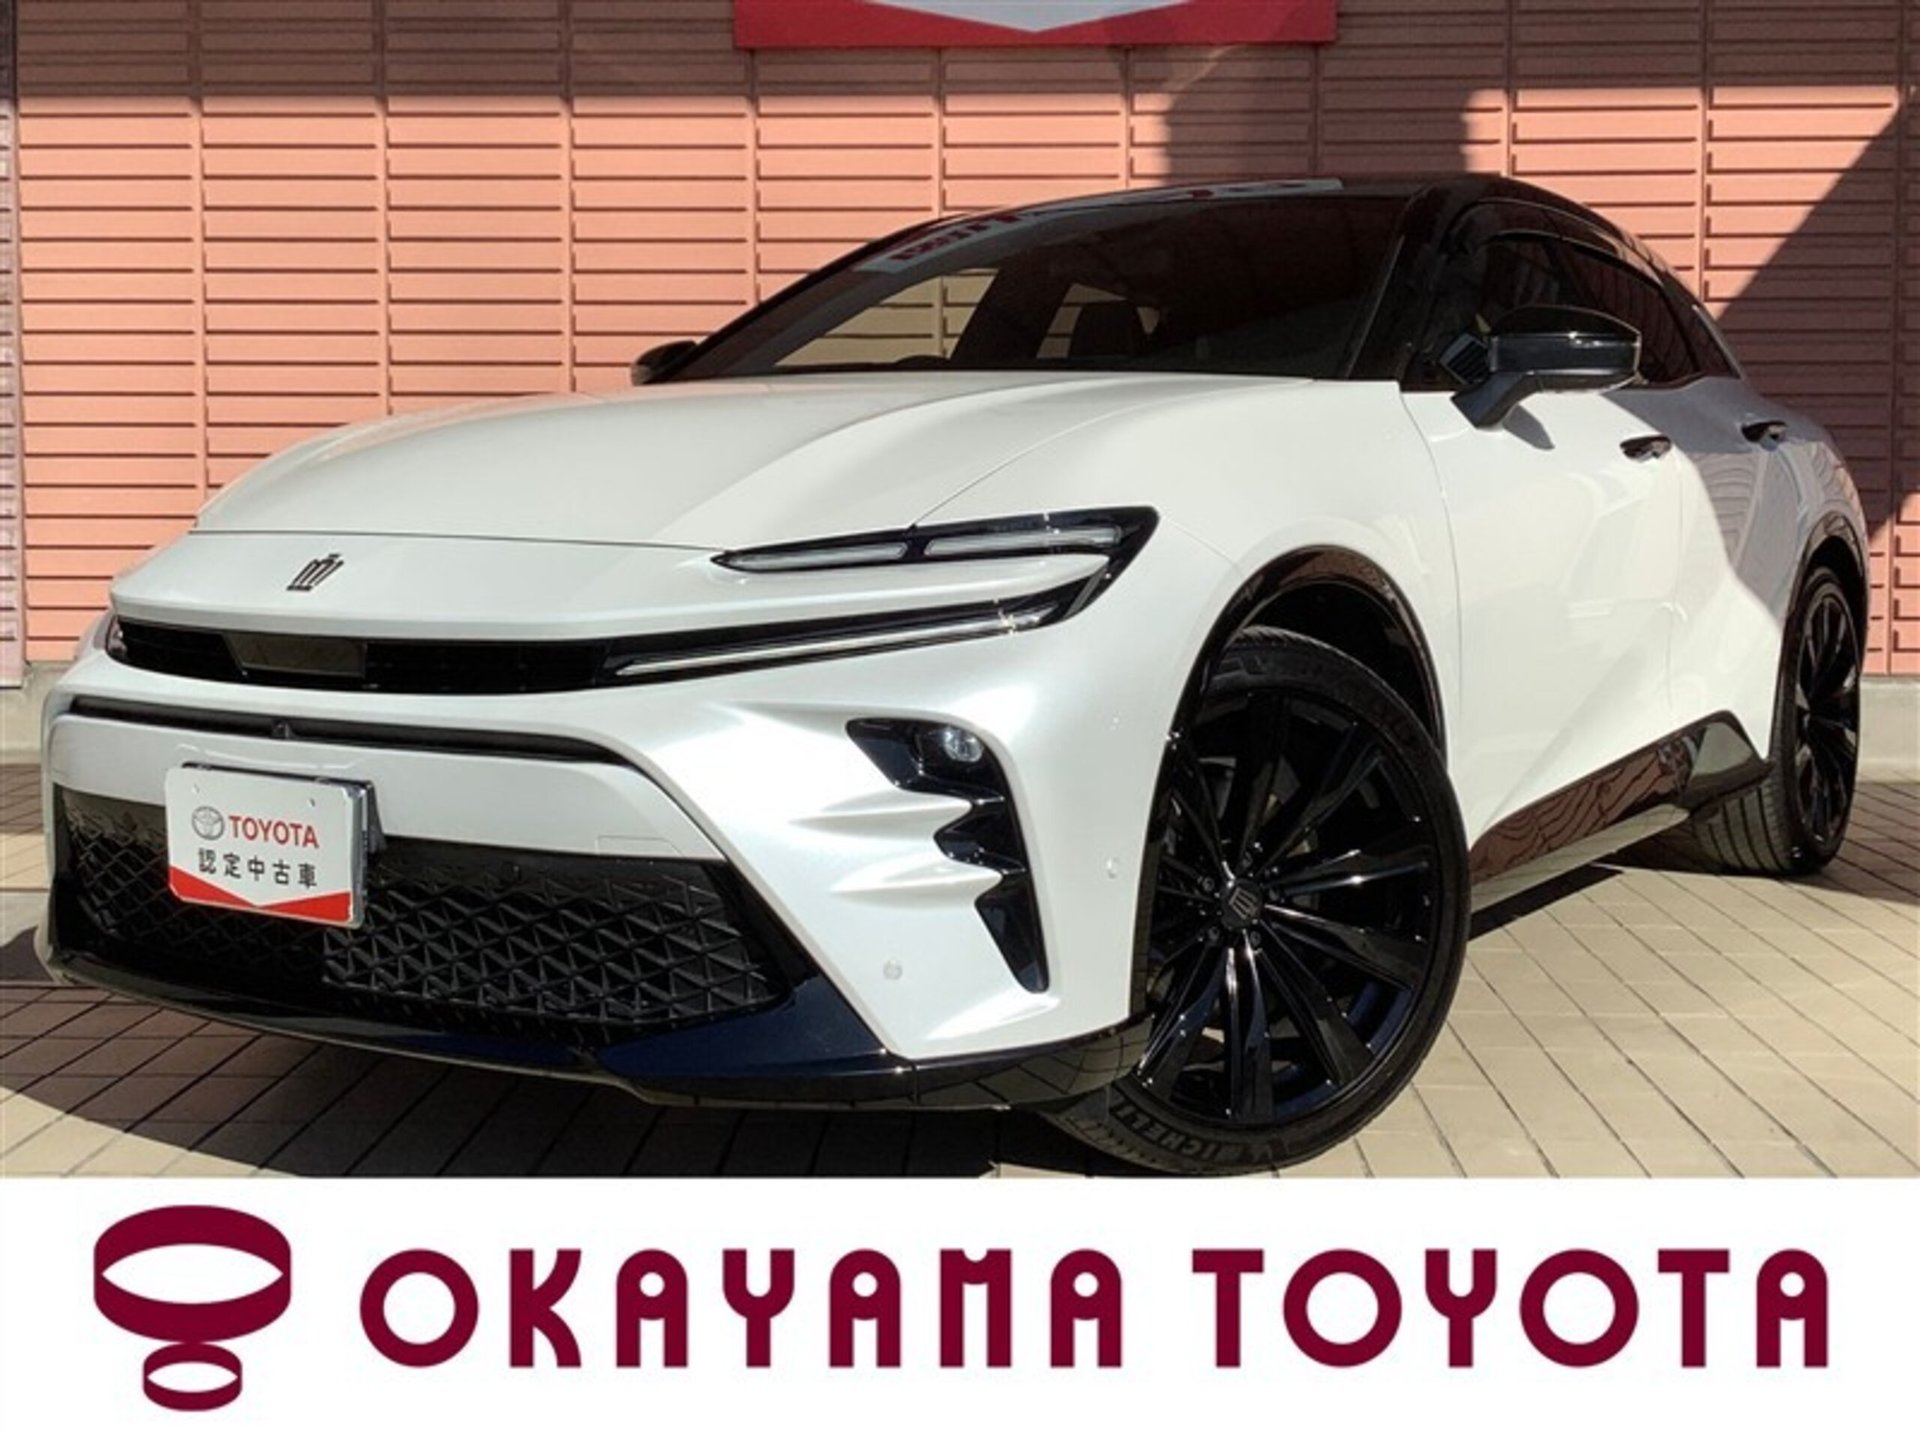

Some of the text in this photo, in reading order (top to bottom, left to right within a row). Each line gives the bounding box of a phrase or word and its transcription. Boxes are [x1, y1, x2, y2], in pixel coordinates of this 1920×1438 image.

[228, 815, 320, 849] TOYOTA
[198, 847, 317, 889] 認定中古車
